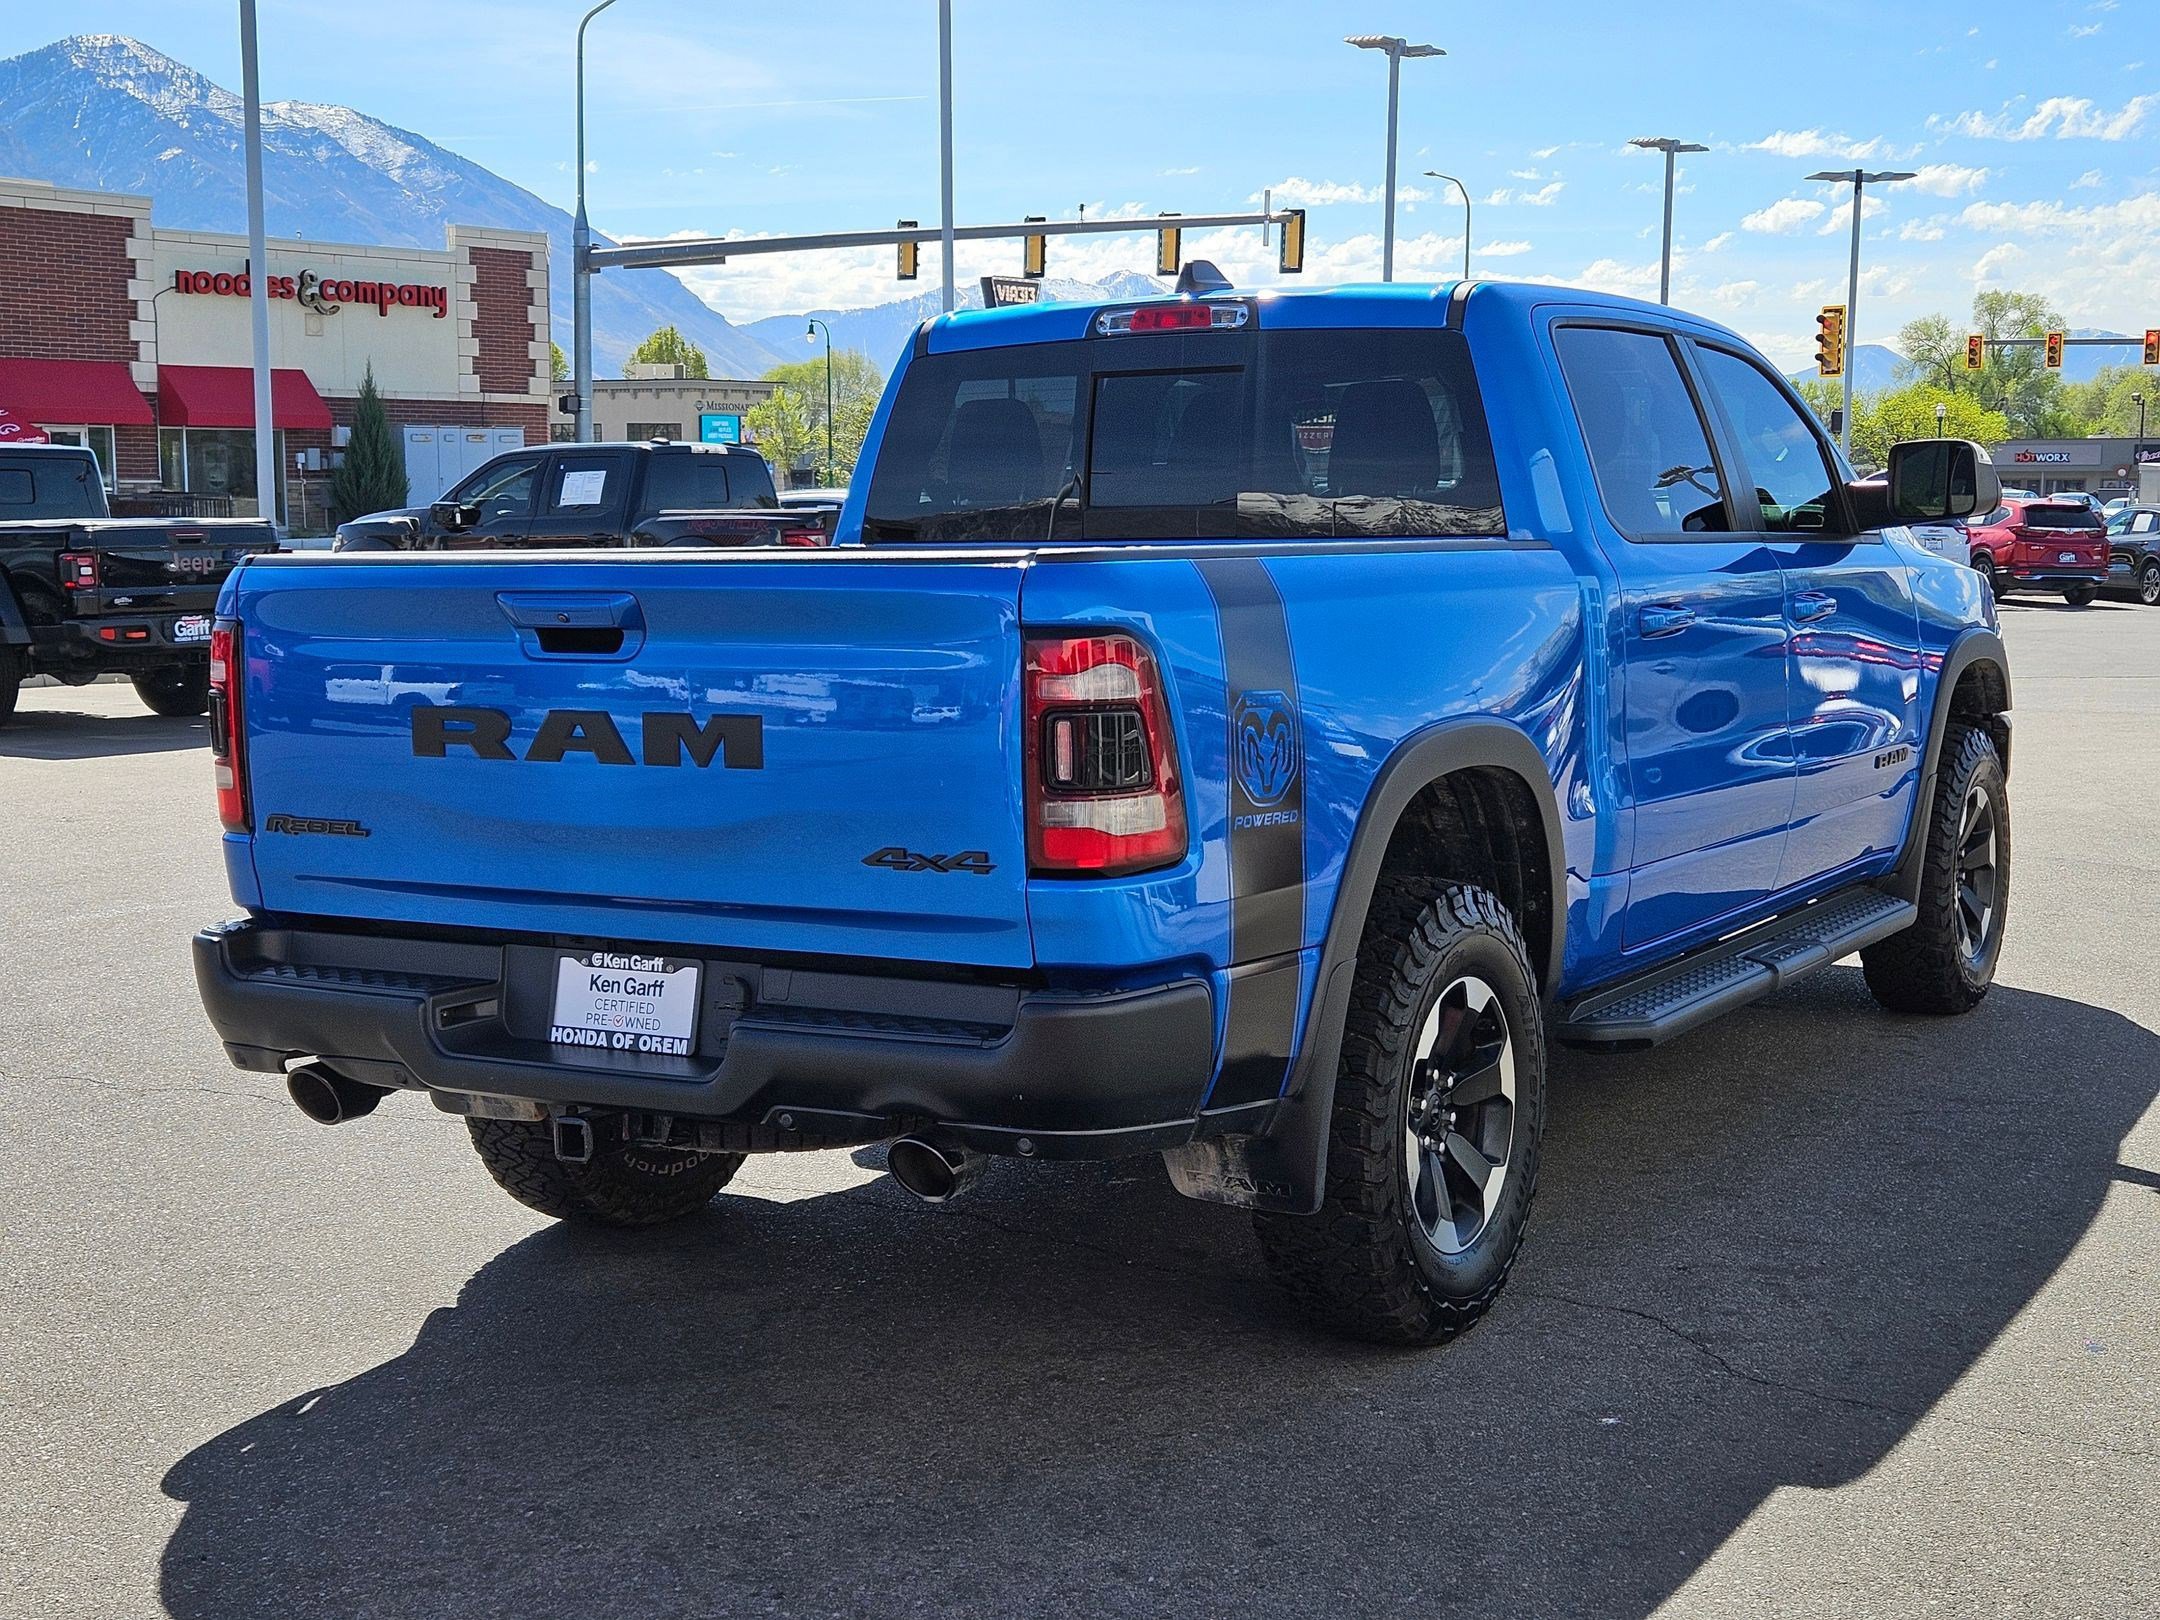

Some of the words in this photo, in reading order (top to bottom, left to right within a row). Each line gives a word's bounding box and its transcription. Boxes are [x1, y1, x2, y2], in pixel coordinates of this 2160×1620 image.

[175, 259, 297, 300] noodes
[319, 278, 448, 319] company
[2015, 450, 2070, 463] HOTWORX
[167, 551, 216, 575] Jeep
[174, 619, 211, 638] Garff
[411, 705, 765, 769] RAM
[1873, 746, 1909, 770] RAM
[265, 813, 372, 838] REBEL
[1234, 809, 1299, 830] POWERED
[589, 974, 621, 994] Ken
[624, 977, 665, 997] Garff
[594, 998, 655, 1015] CERTIFIED
[550, 1026, 608, 1048] HONDA
[612, 1032, 635, 1050] OF
[638, 1035, 688, 1056] OREM
